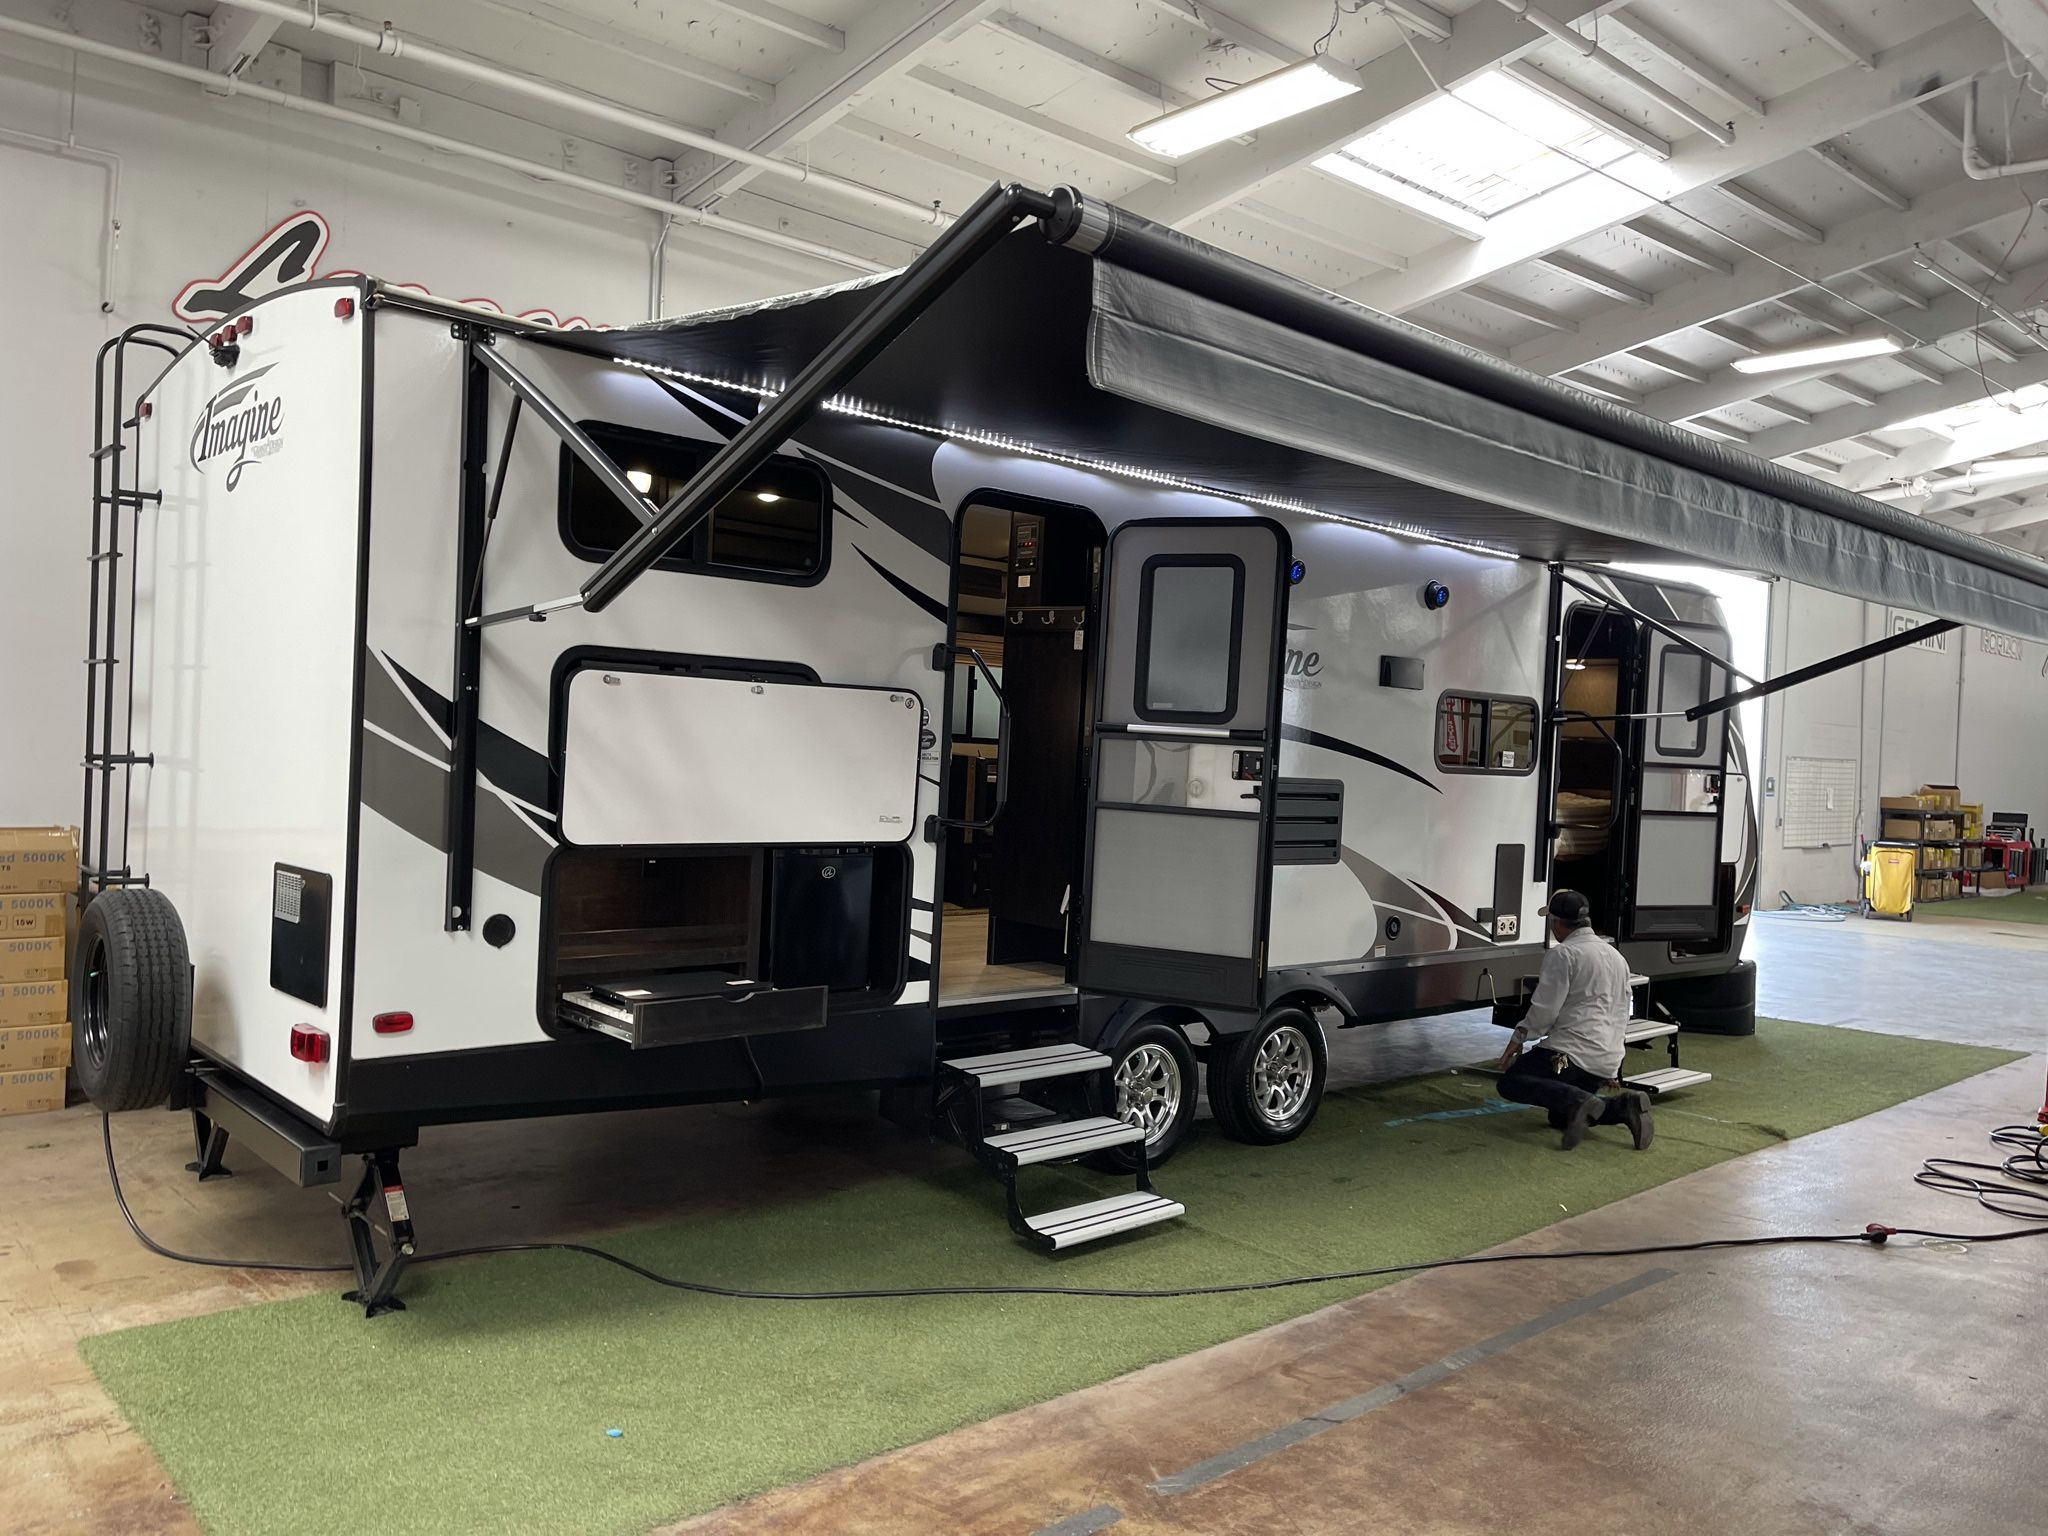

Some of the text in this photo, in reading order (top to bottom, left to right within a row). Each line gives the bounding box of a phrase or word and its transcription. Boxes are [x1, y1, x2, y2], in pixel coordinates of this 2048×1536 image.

[197, 389, 286, 491] Imagine
[23, 852, 65, 863] 5000K
[12, 898, 54, 910] 5000K
[9, 941, 52, 953] 5000K
[13, 984, 56, 996] 5000K
[16, 1028, 60, 1041] 5000K
[11, 1072, 54, 1085] 5000K
